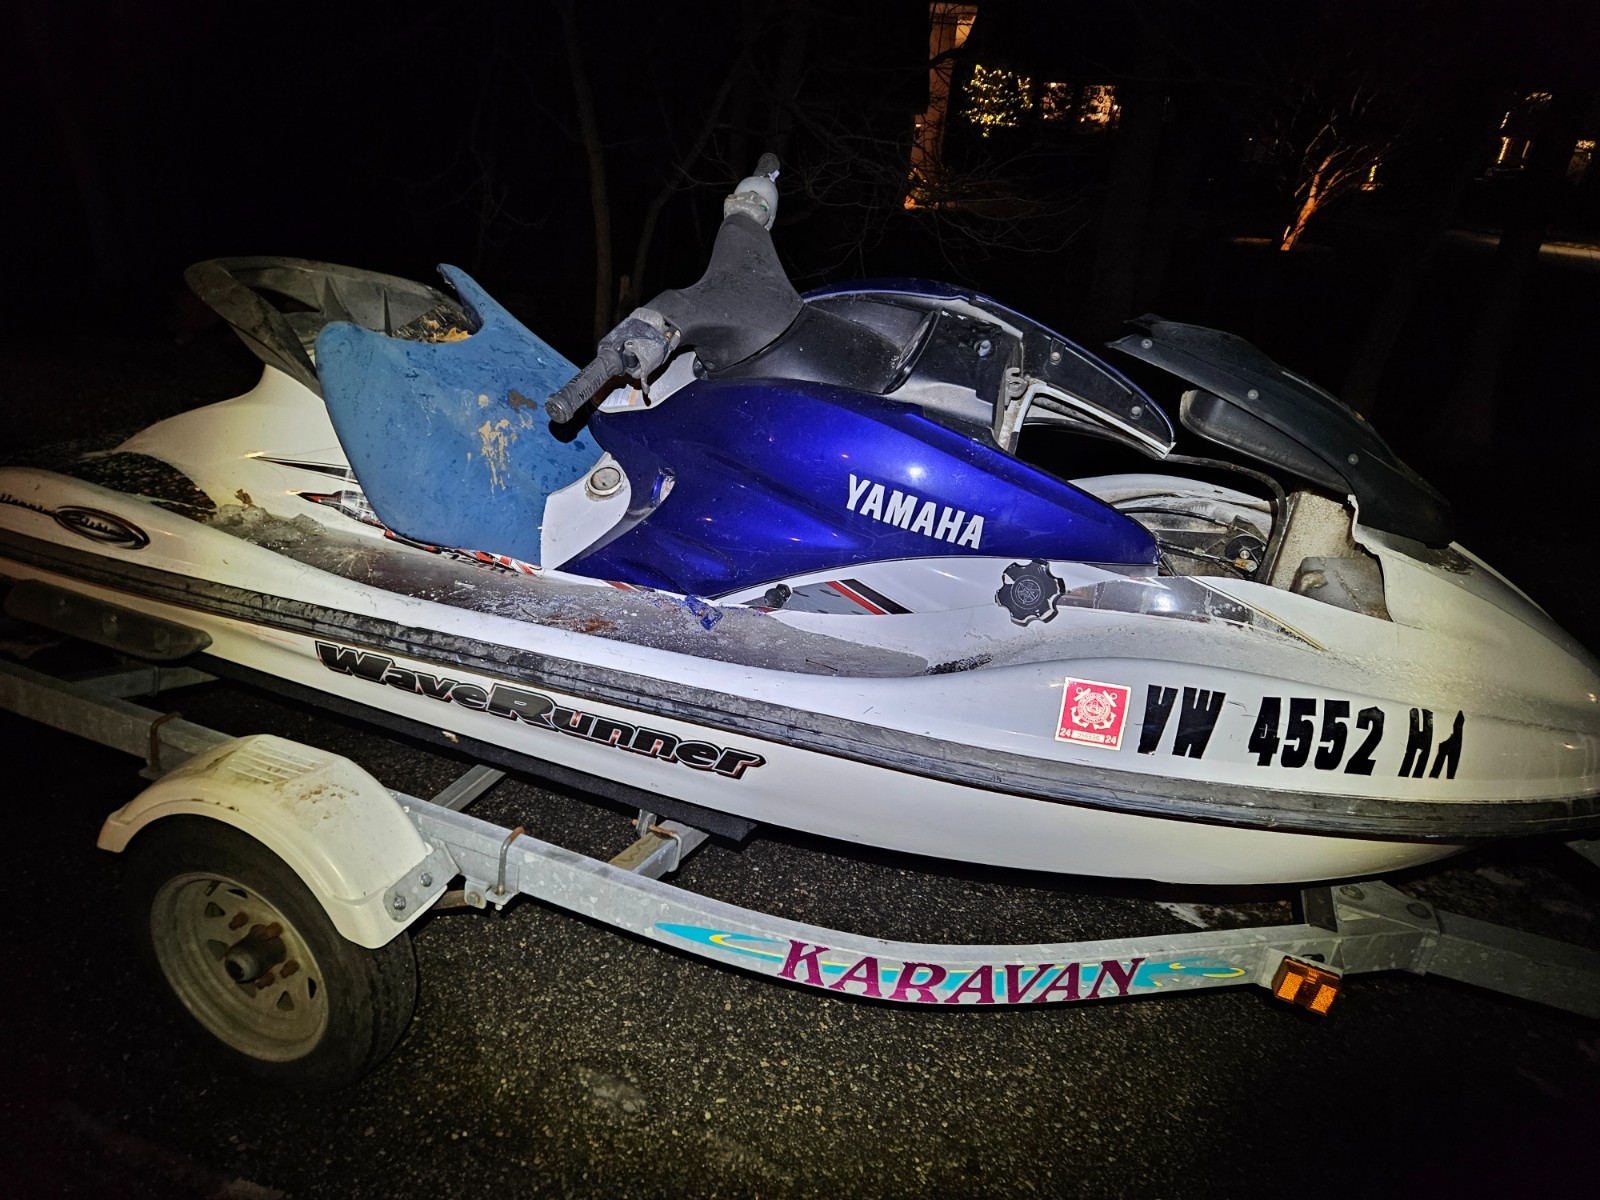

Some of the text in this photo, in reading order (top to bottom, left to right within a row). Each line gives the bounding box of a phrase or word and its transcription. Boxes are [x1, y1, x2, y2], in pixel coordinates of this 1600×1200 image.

[846, 473, 985, 550] YAMAHA
[315, 640, 766, 779] WaveRunner
[1060, 728, 1072, 738] 24
[1105, 735, 1117, 744] 24
[1248, 697, 1385, 776] 4552
[776, 940, 1145, 1004] KARAVAN
